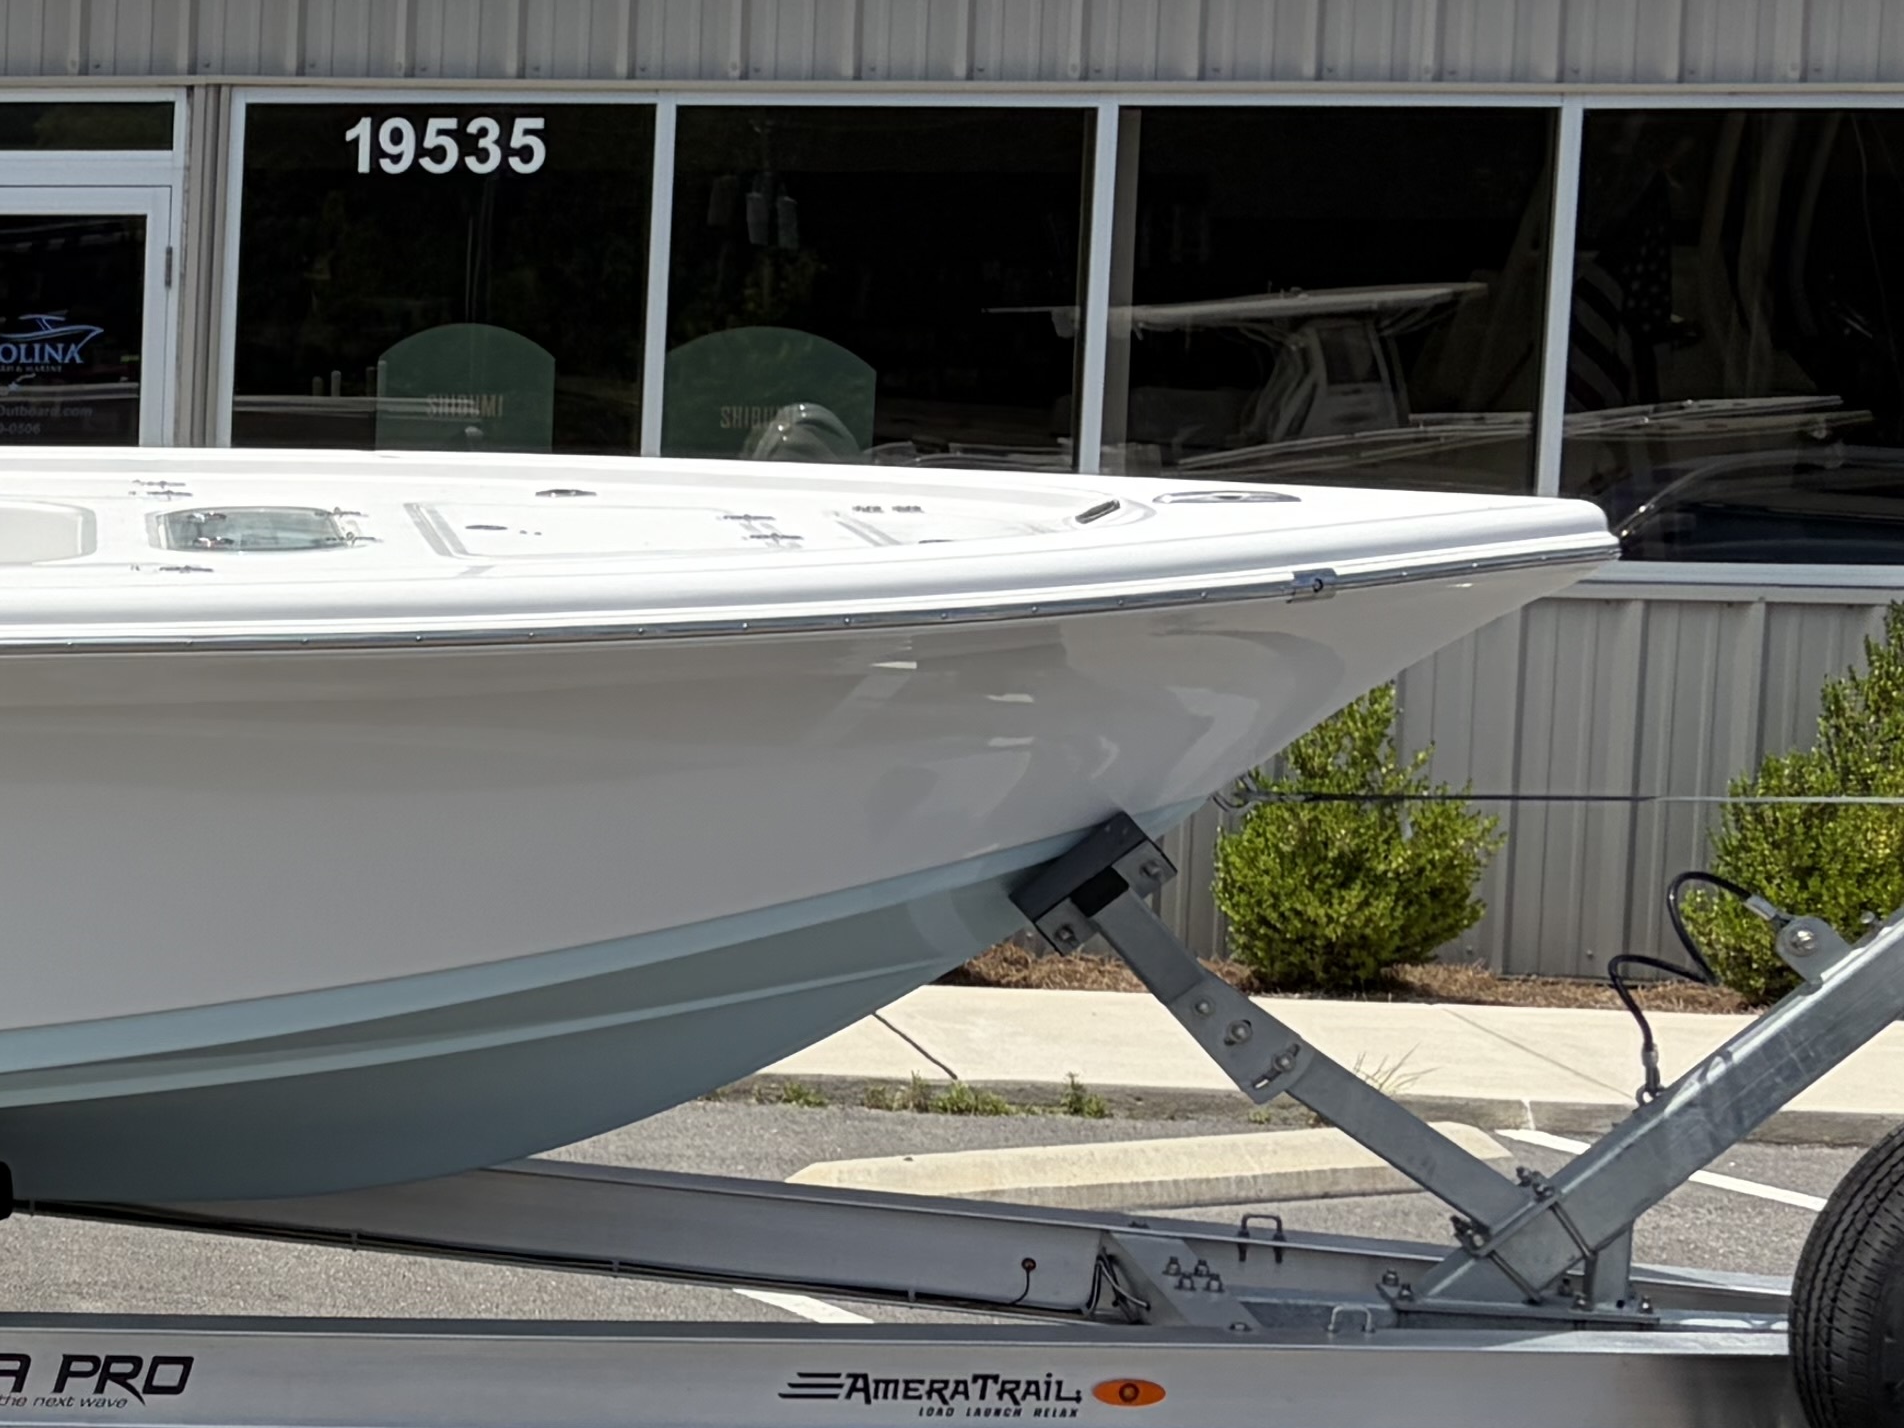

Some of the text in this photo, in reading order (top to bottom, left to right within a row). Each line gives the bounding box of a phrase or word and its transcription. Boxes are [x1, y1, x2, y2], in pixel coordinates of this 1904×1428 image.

[345, 116, 546, 174] 19535
[52, 1354, 194, 1406] PRO
[33, 1396, 75, 1408] next
[80, 1397, 127, 1409] wave
[919, 1406, 1078, 1418] LOAD LAUNCH RELAX
